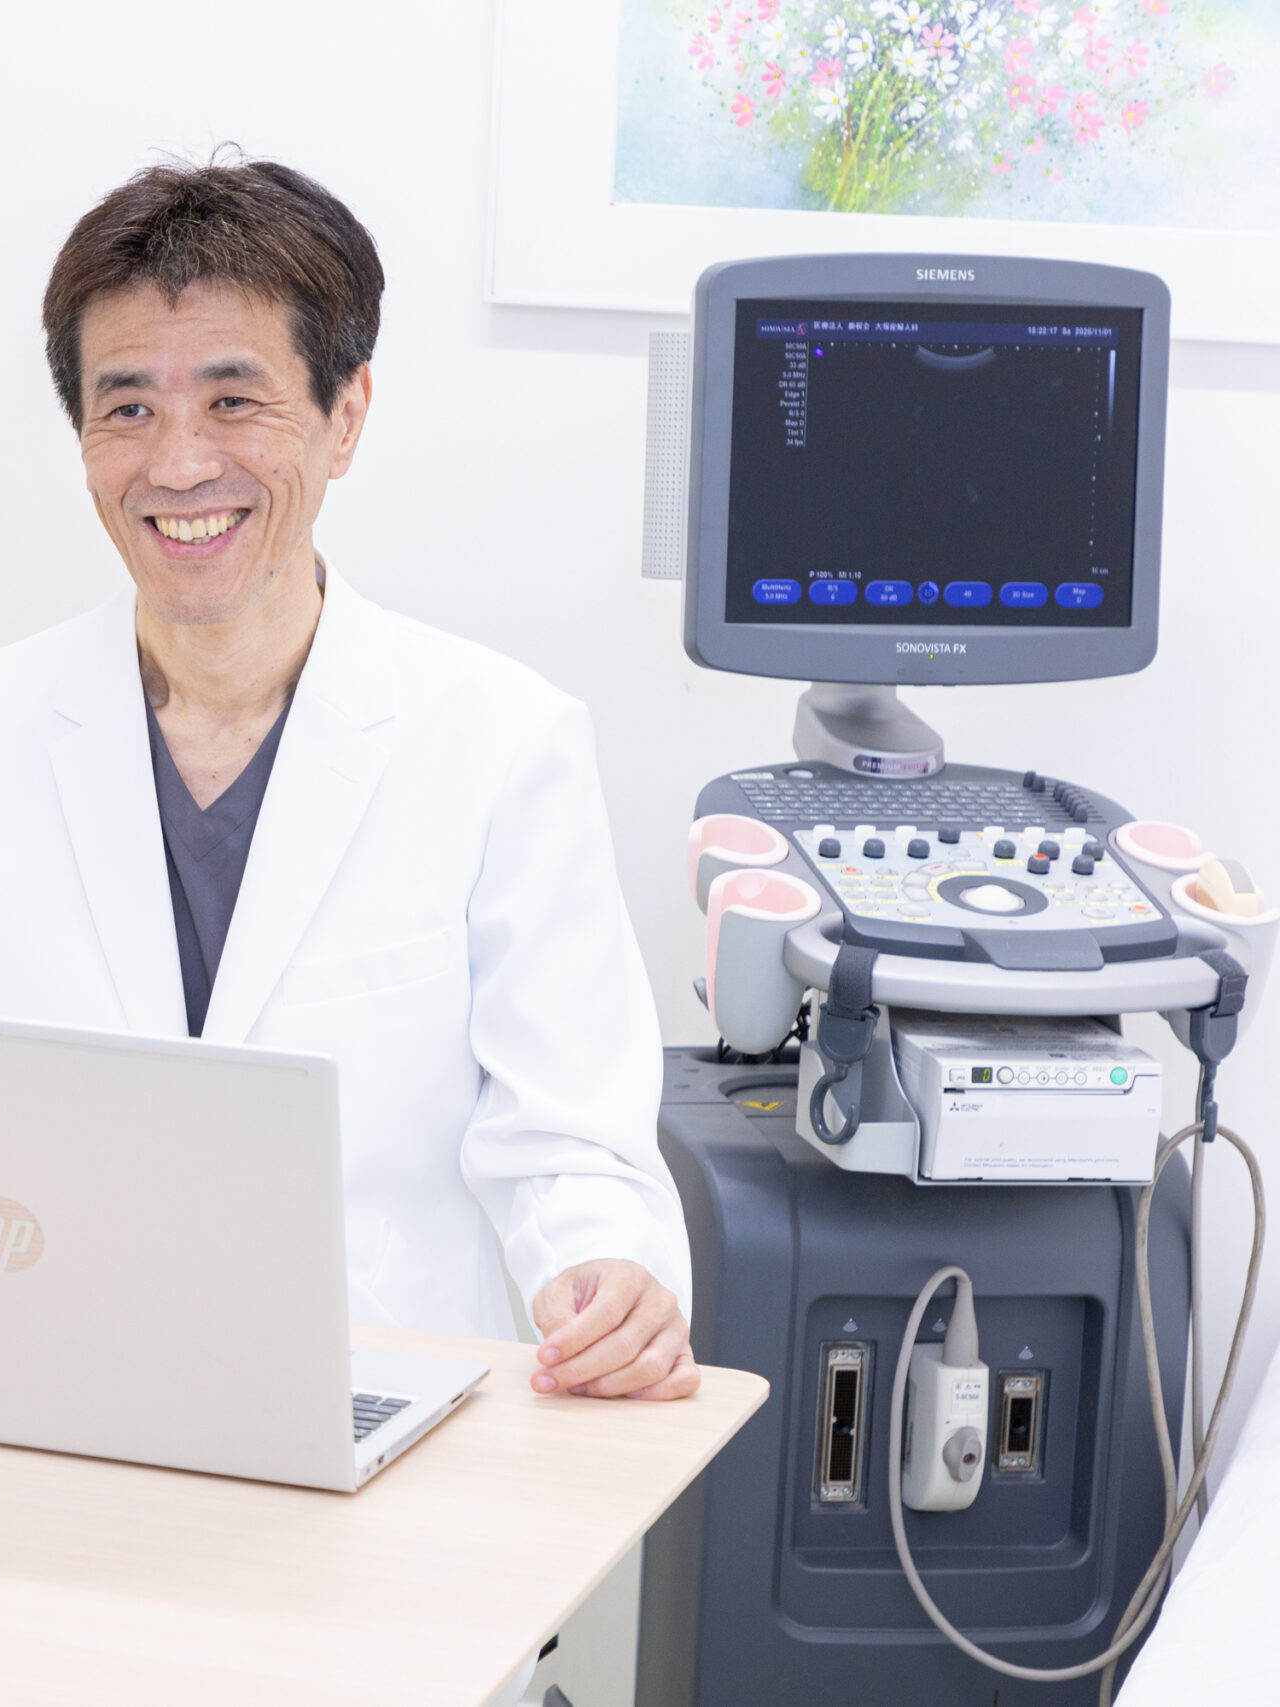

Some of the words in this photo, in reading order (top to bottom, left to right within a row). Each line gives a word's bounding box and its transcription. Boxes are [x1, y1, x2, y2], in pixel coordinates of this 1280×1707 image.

[916, 268, 975, 281] SIEMENS
[895, 642, 951, 654] SONOVISTA
[953, 643, 967, 654] FX
